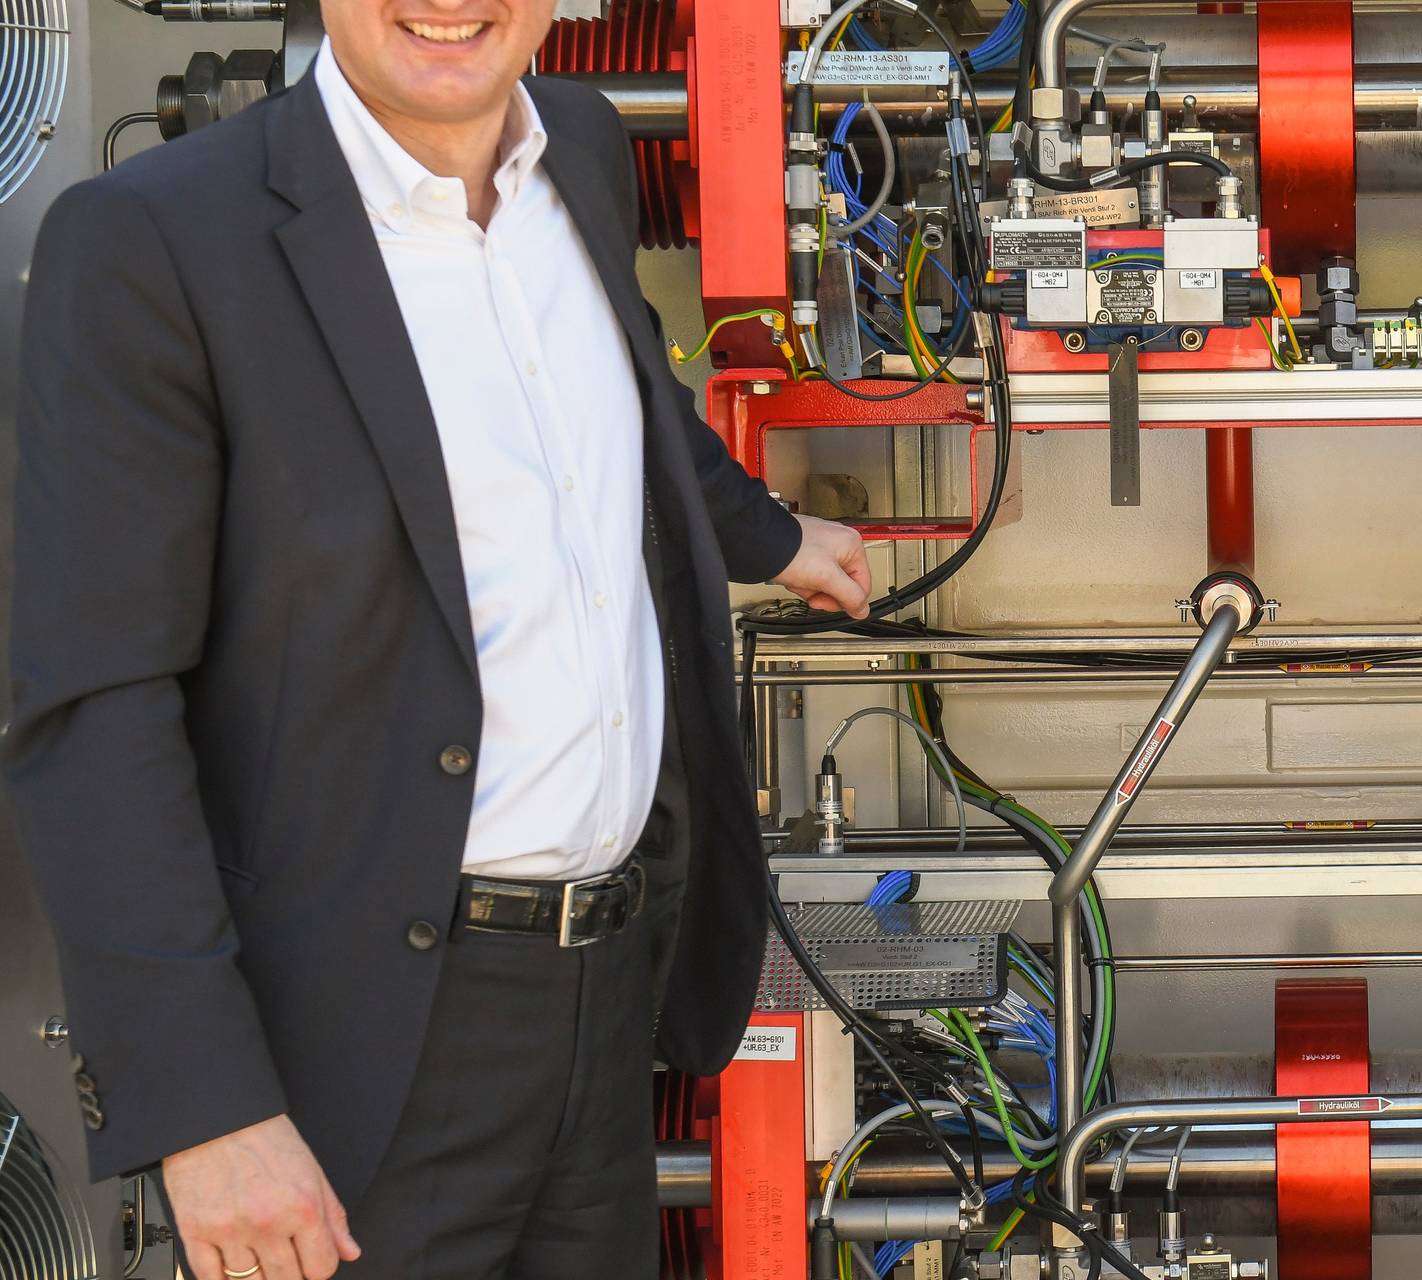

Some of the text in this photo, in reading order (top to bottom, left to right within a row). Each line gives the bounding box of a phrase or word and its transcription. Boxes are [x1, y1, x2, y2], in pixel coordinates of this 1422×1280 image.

[830, 55, 909, 63] 02-RHM-13-AS301
[1097, 205, 1110, 213] Stuf
[1131, 739, 1160, 779] Hydrauliköl
[1319, 1101, 1360, 1112] Hydrauliköl
